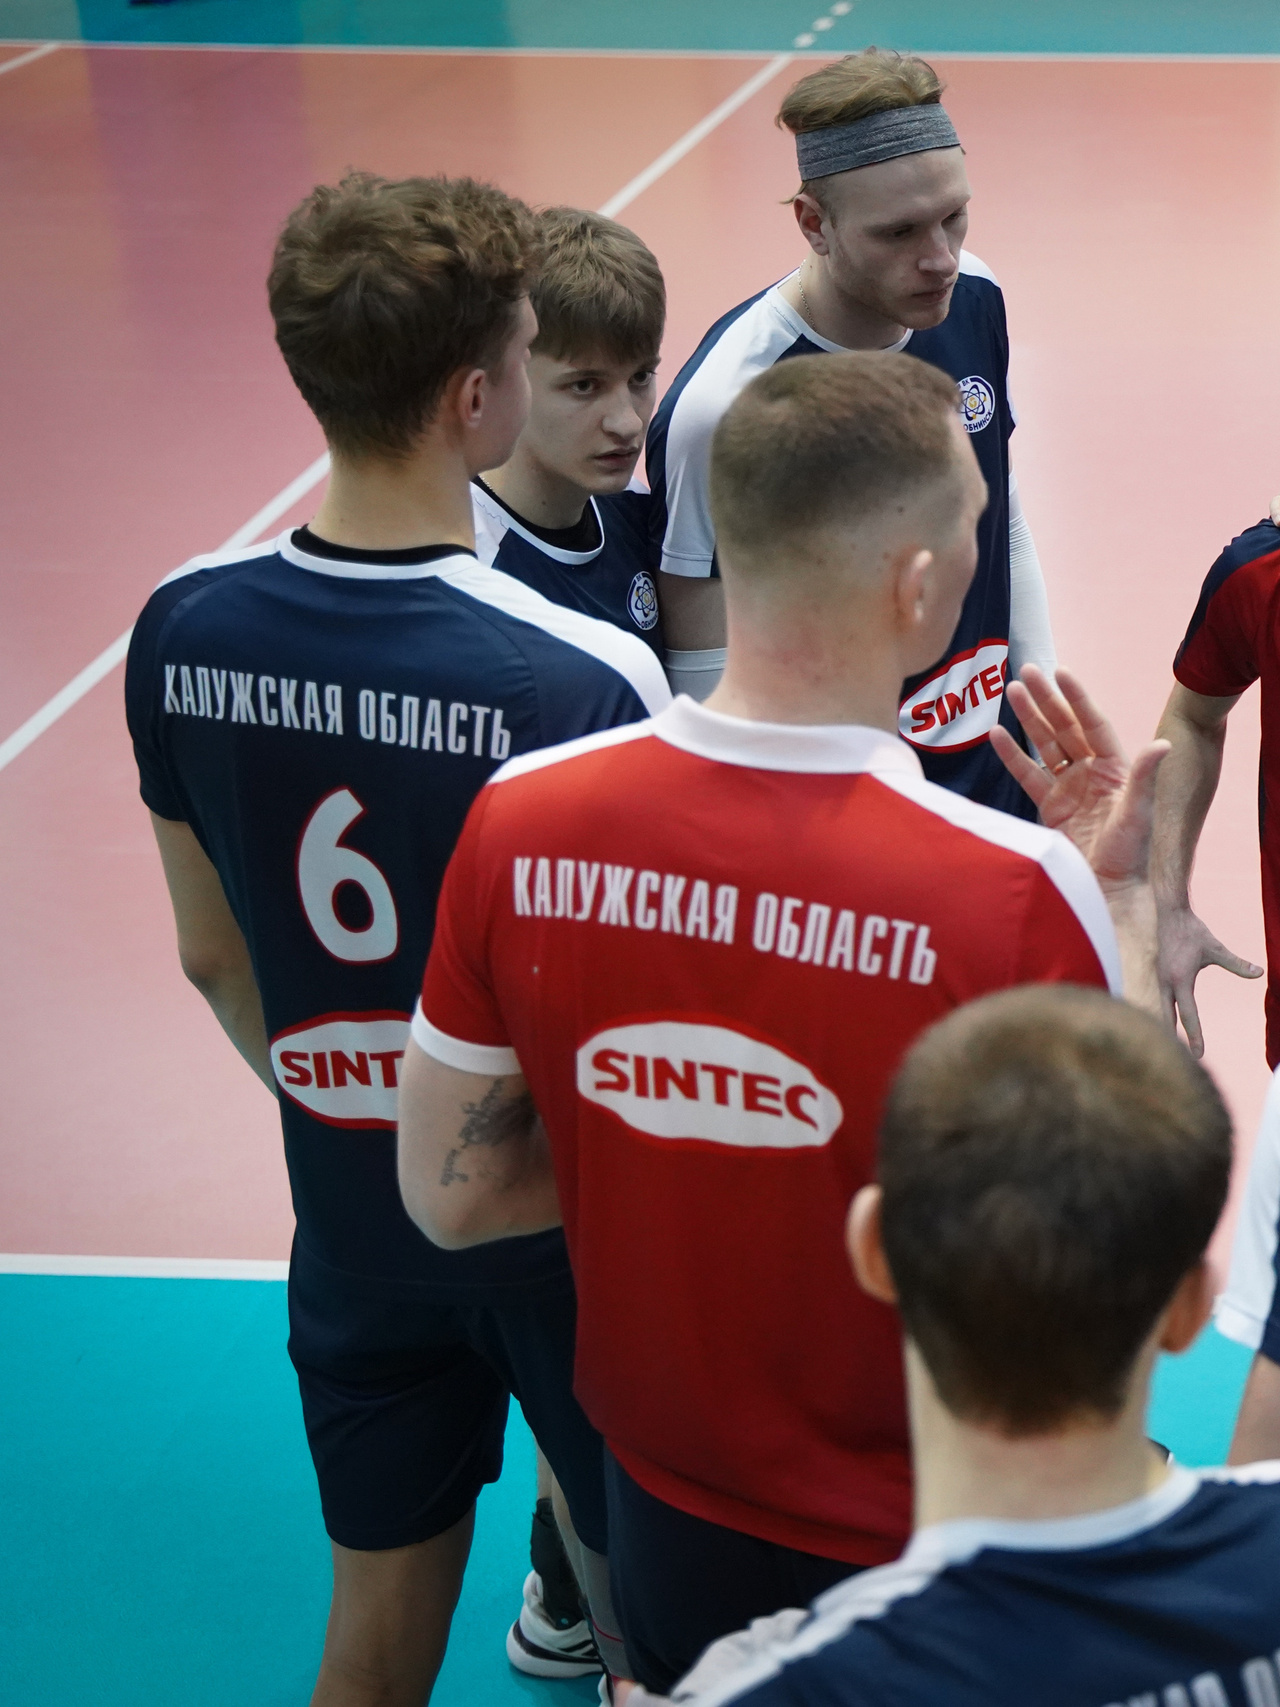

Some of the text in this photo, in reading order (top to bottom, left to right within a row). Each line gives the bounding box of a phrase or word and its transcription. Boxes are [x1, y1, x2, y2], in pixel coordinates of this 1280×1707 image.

[164, 664, 512, 761] КАЛУЖСКАЯ ОБЛАСТЬ
[297, 786, 399, 964] 6
[513, 856, 938, 986] КАЛУЖСКАЯ ОБЛАСТЬ
[279, 1050, 405, 1089] SINT
[591, 1048, 819, 1132] SINTEC
